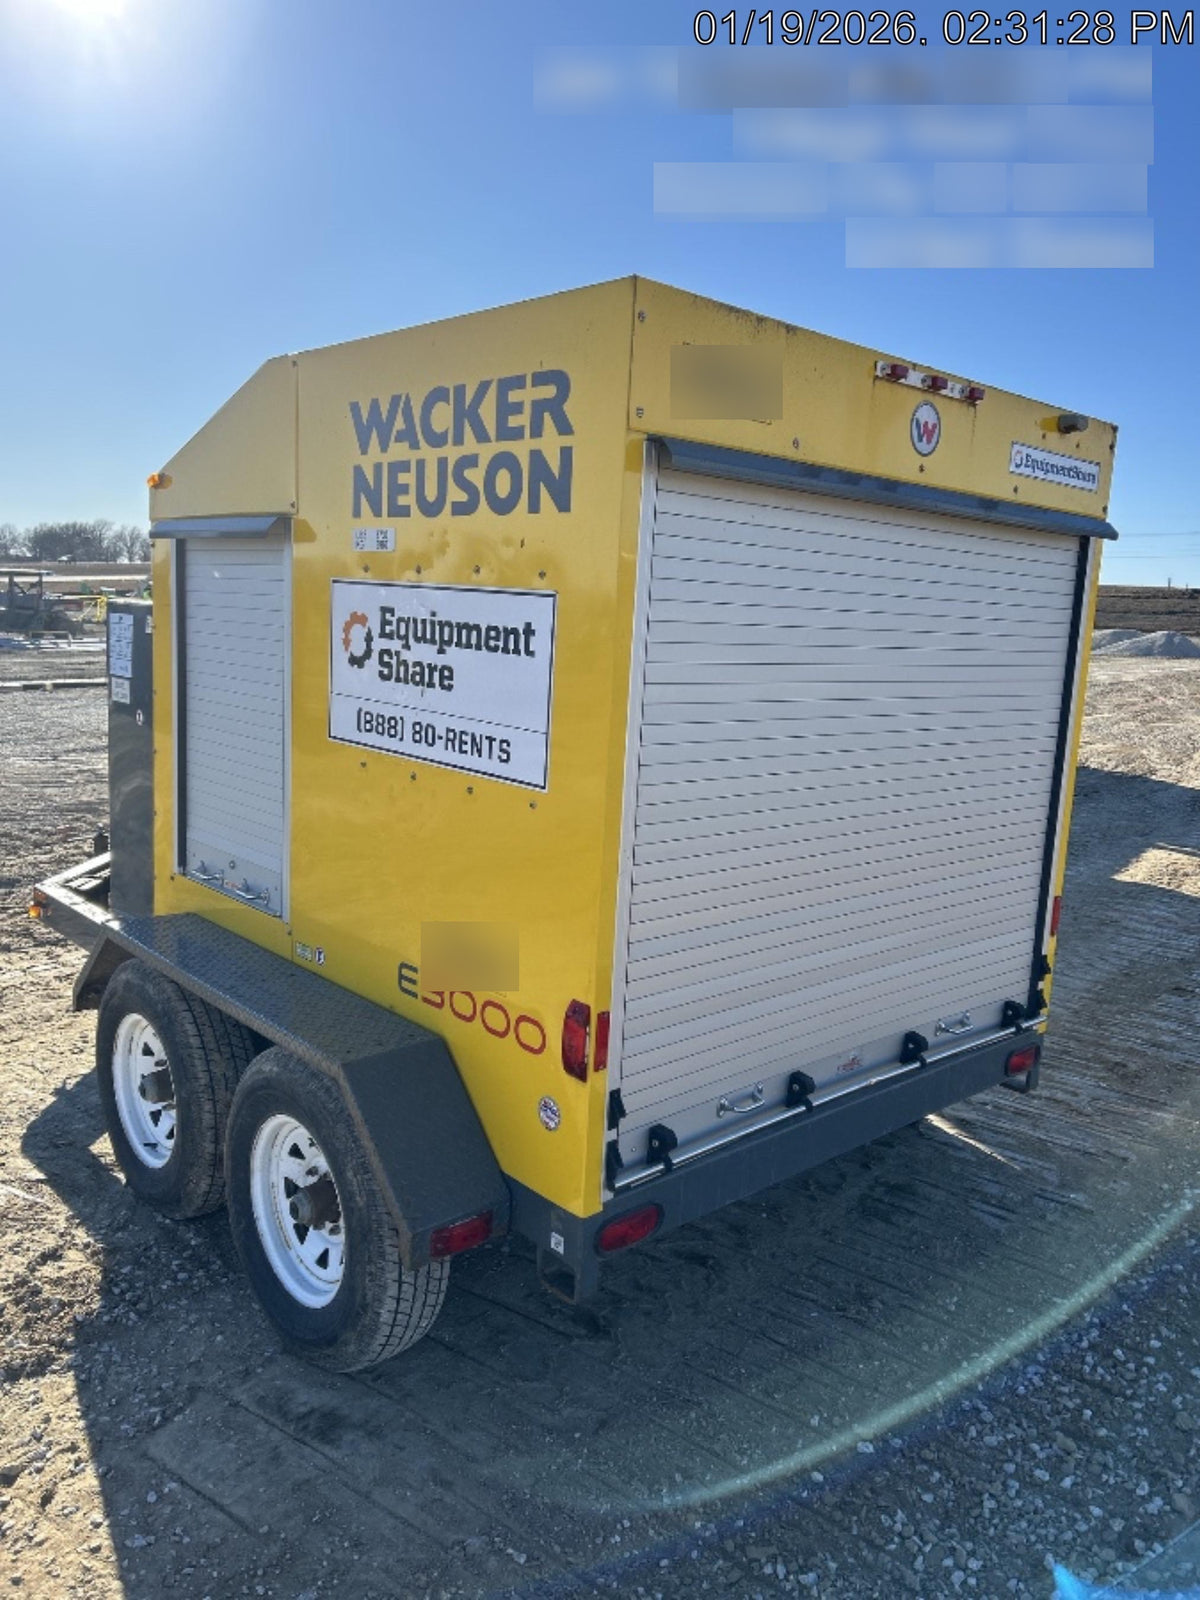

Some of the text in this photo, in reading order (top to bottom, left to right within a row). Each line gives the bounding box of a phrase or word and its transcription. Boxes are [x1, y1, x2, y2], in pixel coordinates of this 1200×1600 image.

[349, 369, 575, 456] WACKER
[352, 446, 574, 519] NEUSON
[378, 606, 536, 658] Equipment
[378, 648, 454, 692] Share
[411, 721, 511, 764] 80-RENTS
